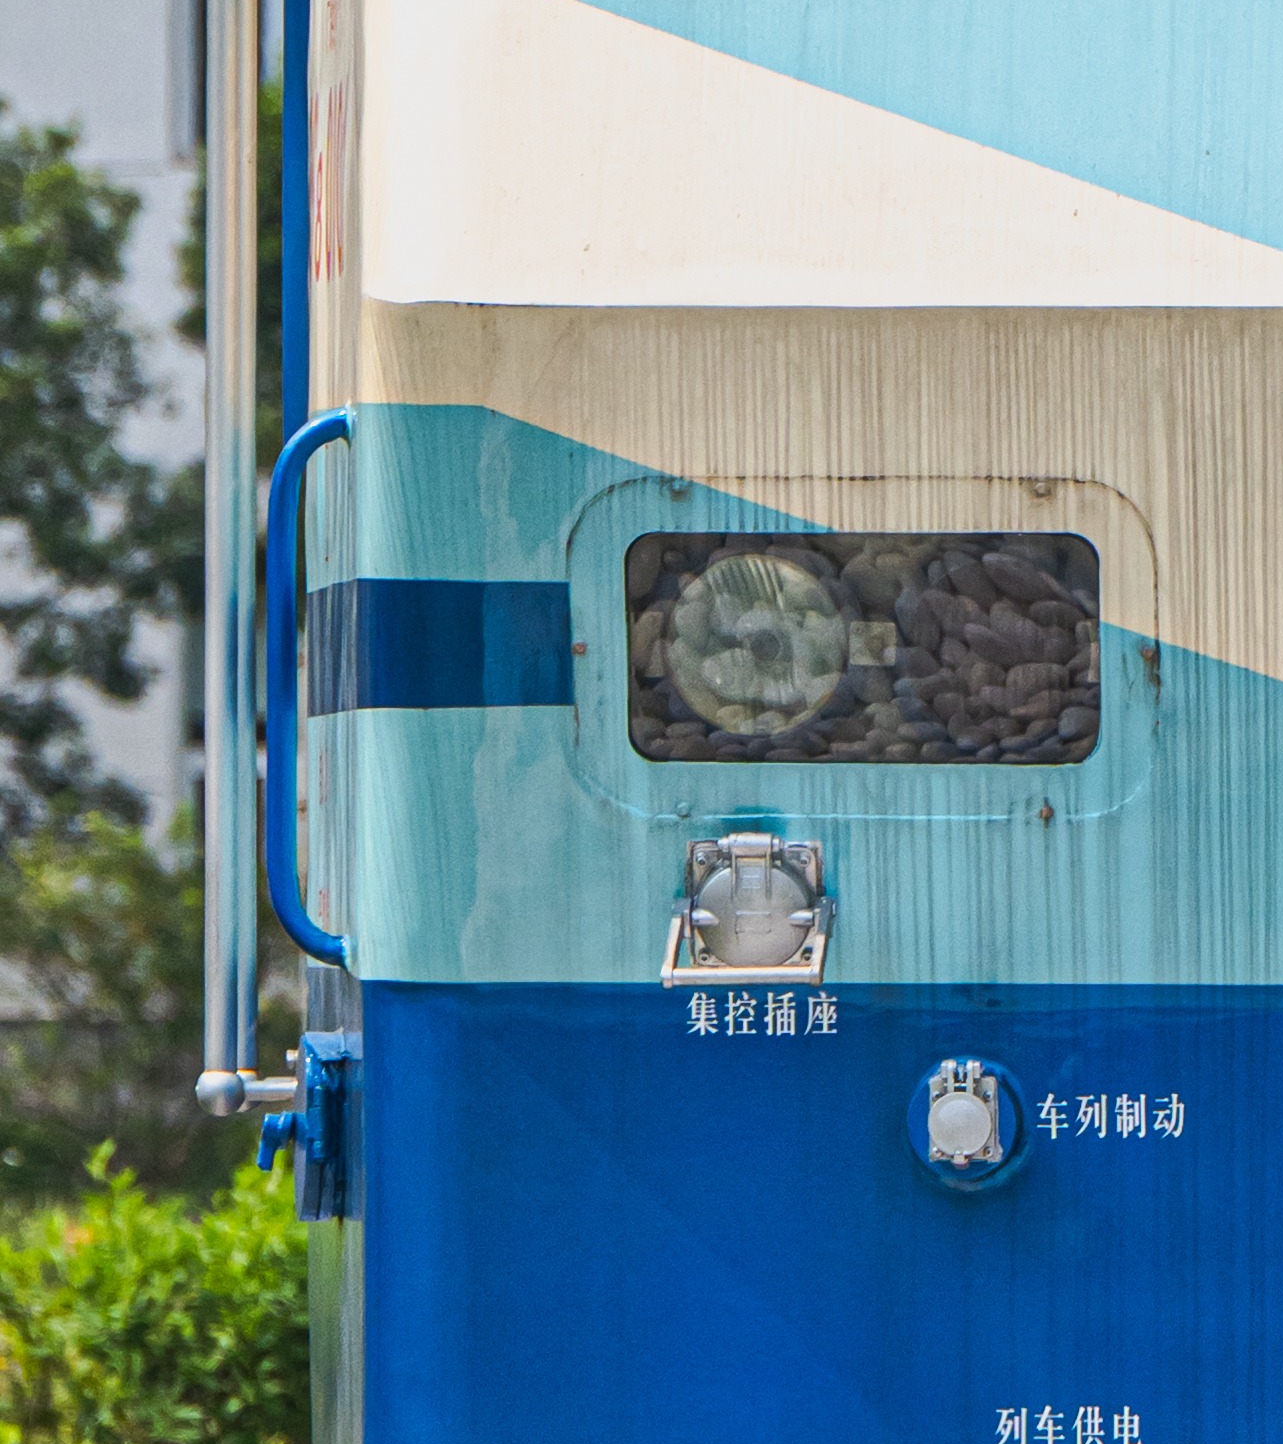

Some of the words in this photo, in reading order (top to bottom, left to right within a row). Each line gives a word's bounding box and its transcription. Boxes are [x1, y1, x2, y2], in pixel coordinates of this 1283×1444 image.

[686, 990, 839, 1036] 集控插座
[1036, 1092, 1186, 1140] 车列制动
